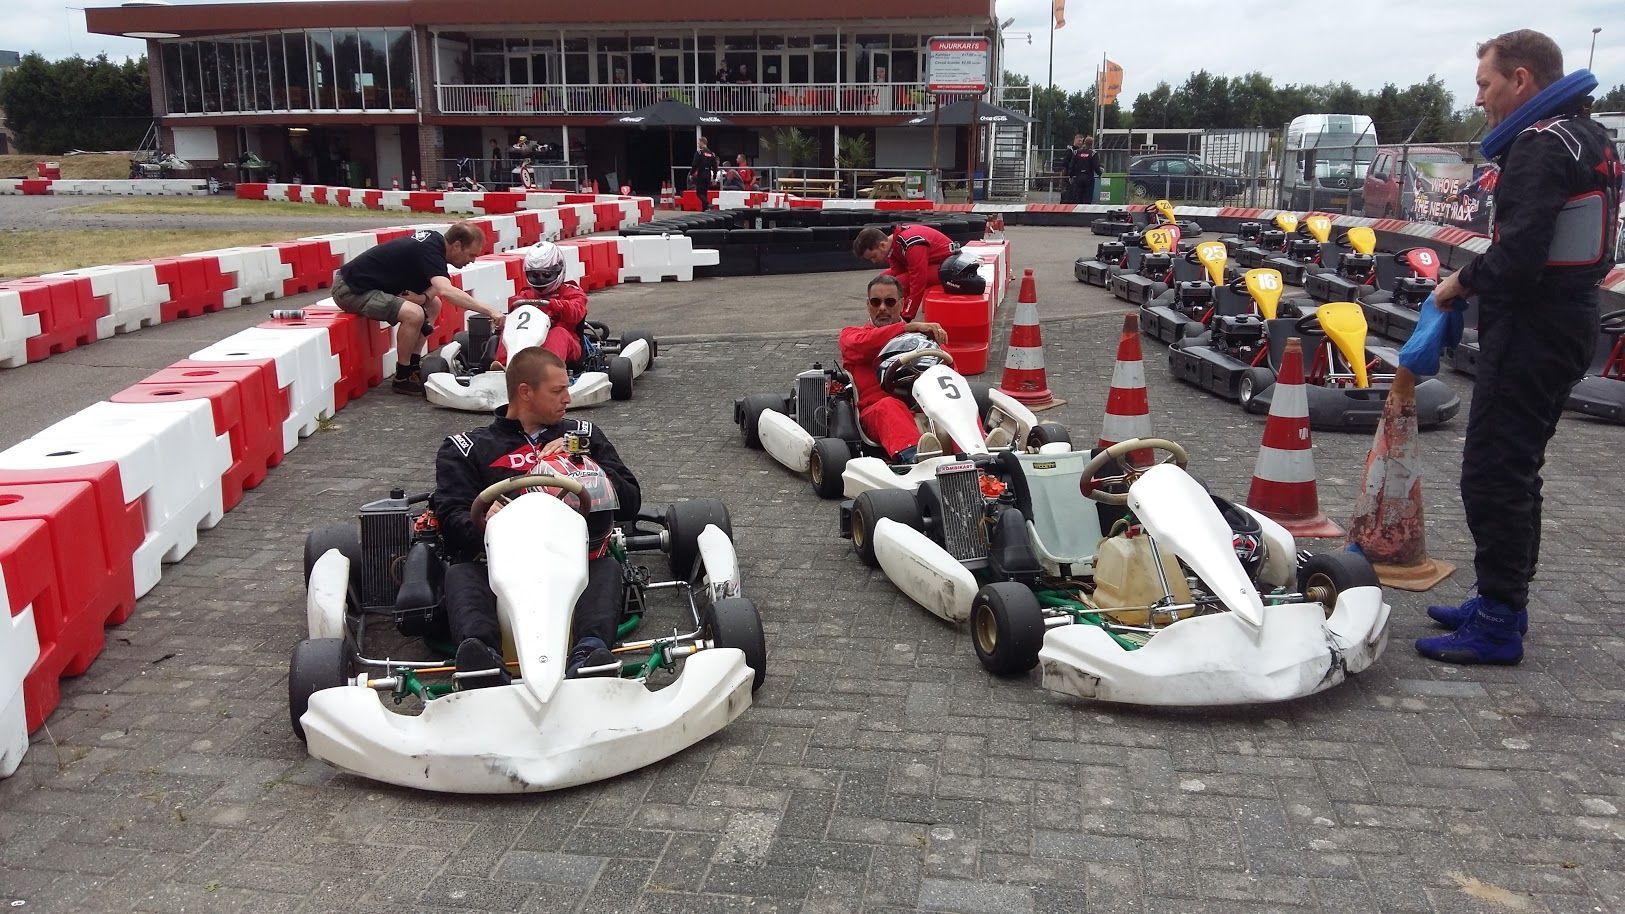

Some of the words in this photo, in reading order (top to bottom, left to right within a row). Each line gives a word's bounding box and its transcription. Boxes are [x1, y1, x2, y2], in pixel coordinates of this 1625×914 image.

[1431, 178, 1449, 194] WHO
[1449, 179, 1459, 195] IS
[1314, 219, 1328, 230] 17
[1152, 232, 1168, 244] 21
[1203, 246, 1225, 261] 25
[1420, 252, 1432, 265] 9
[1258, 273, 1278, 290] 16
[516, 311, 531, 330] 2
[937, 375, 961, 400] 5
